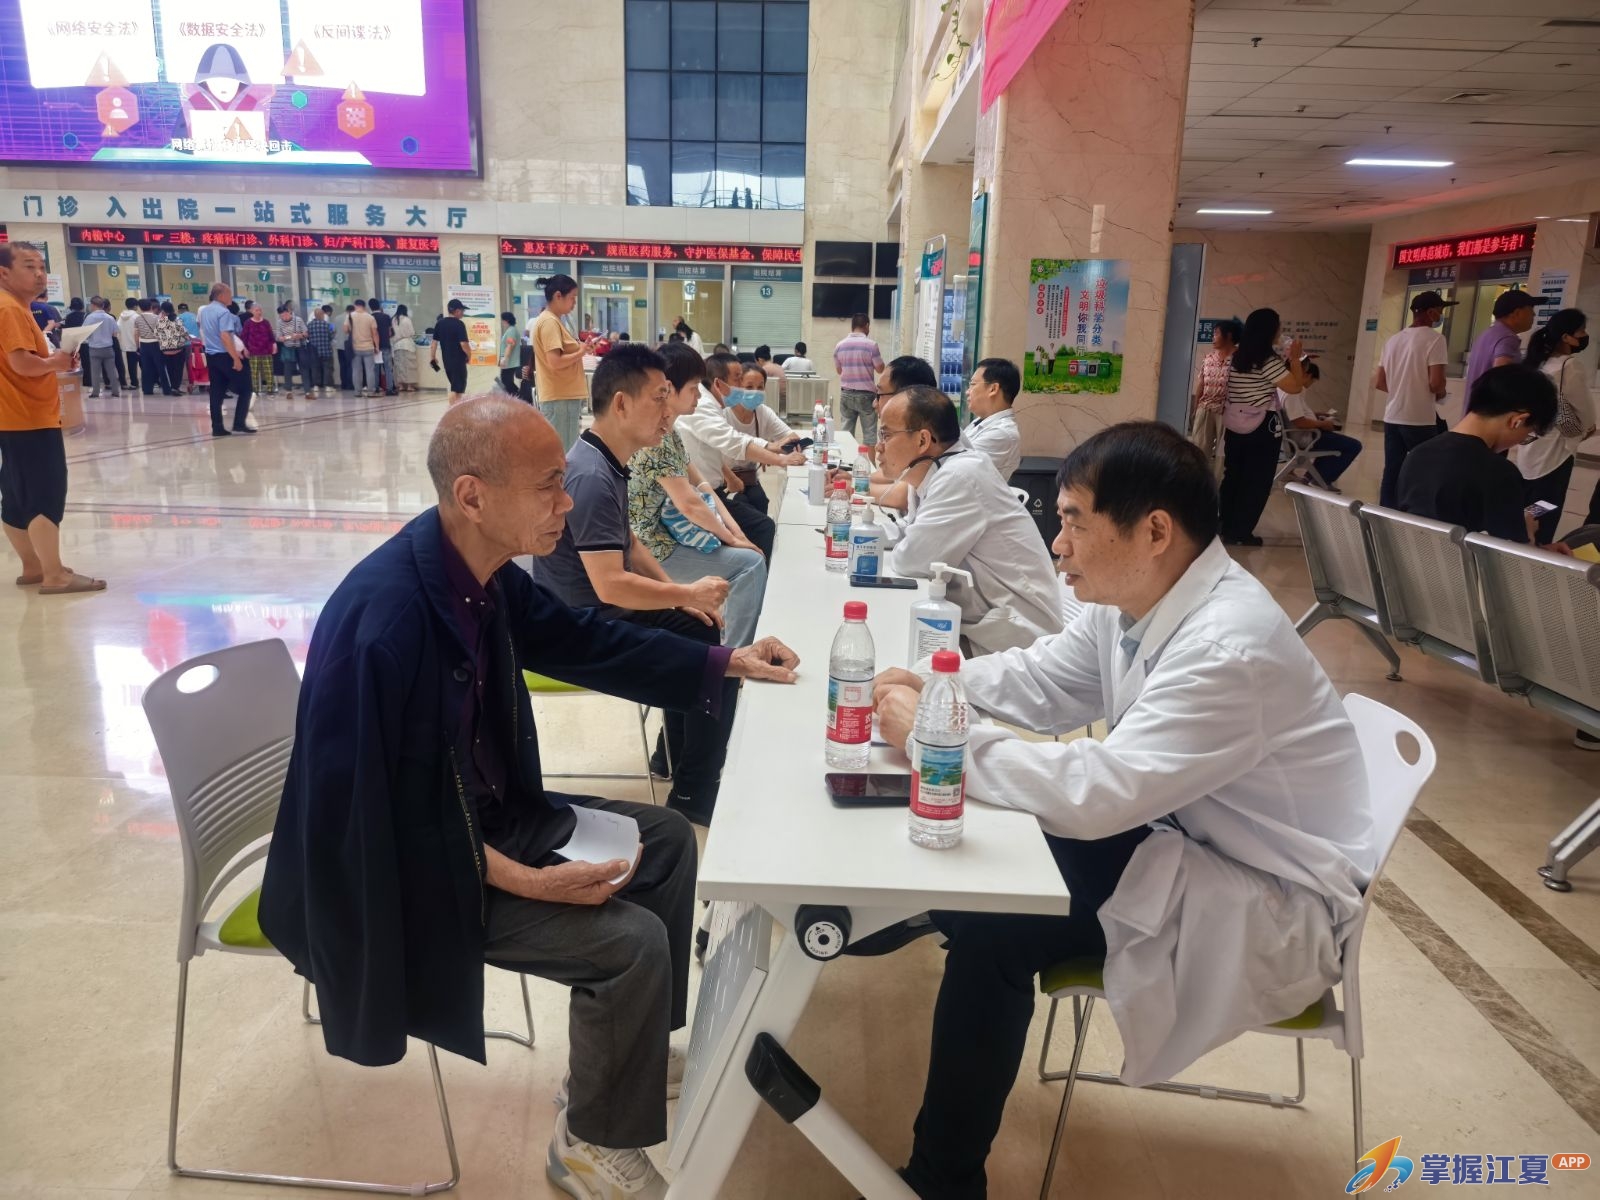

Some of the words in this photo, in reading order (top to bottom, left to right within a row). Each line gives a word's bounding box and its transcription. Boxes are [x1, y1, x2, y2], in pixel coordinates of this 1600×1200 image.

[48, 20, 139, 37] 《网络安全法》
[178, 21, 267, 38] 《数据安全法》
[312, 23, 392, 40] 《反间谍法》
